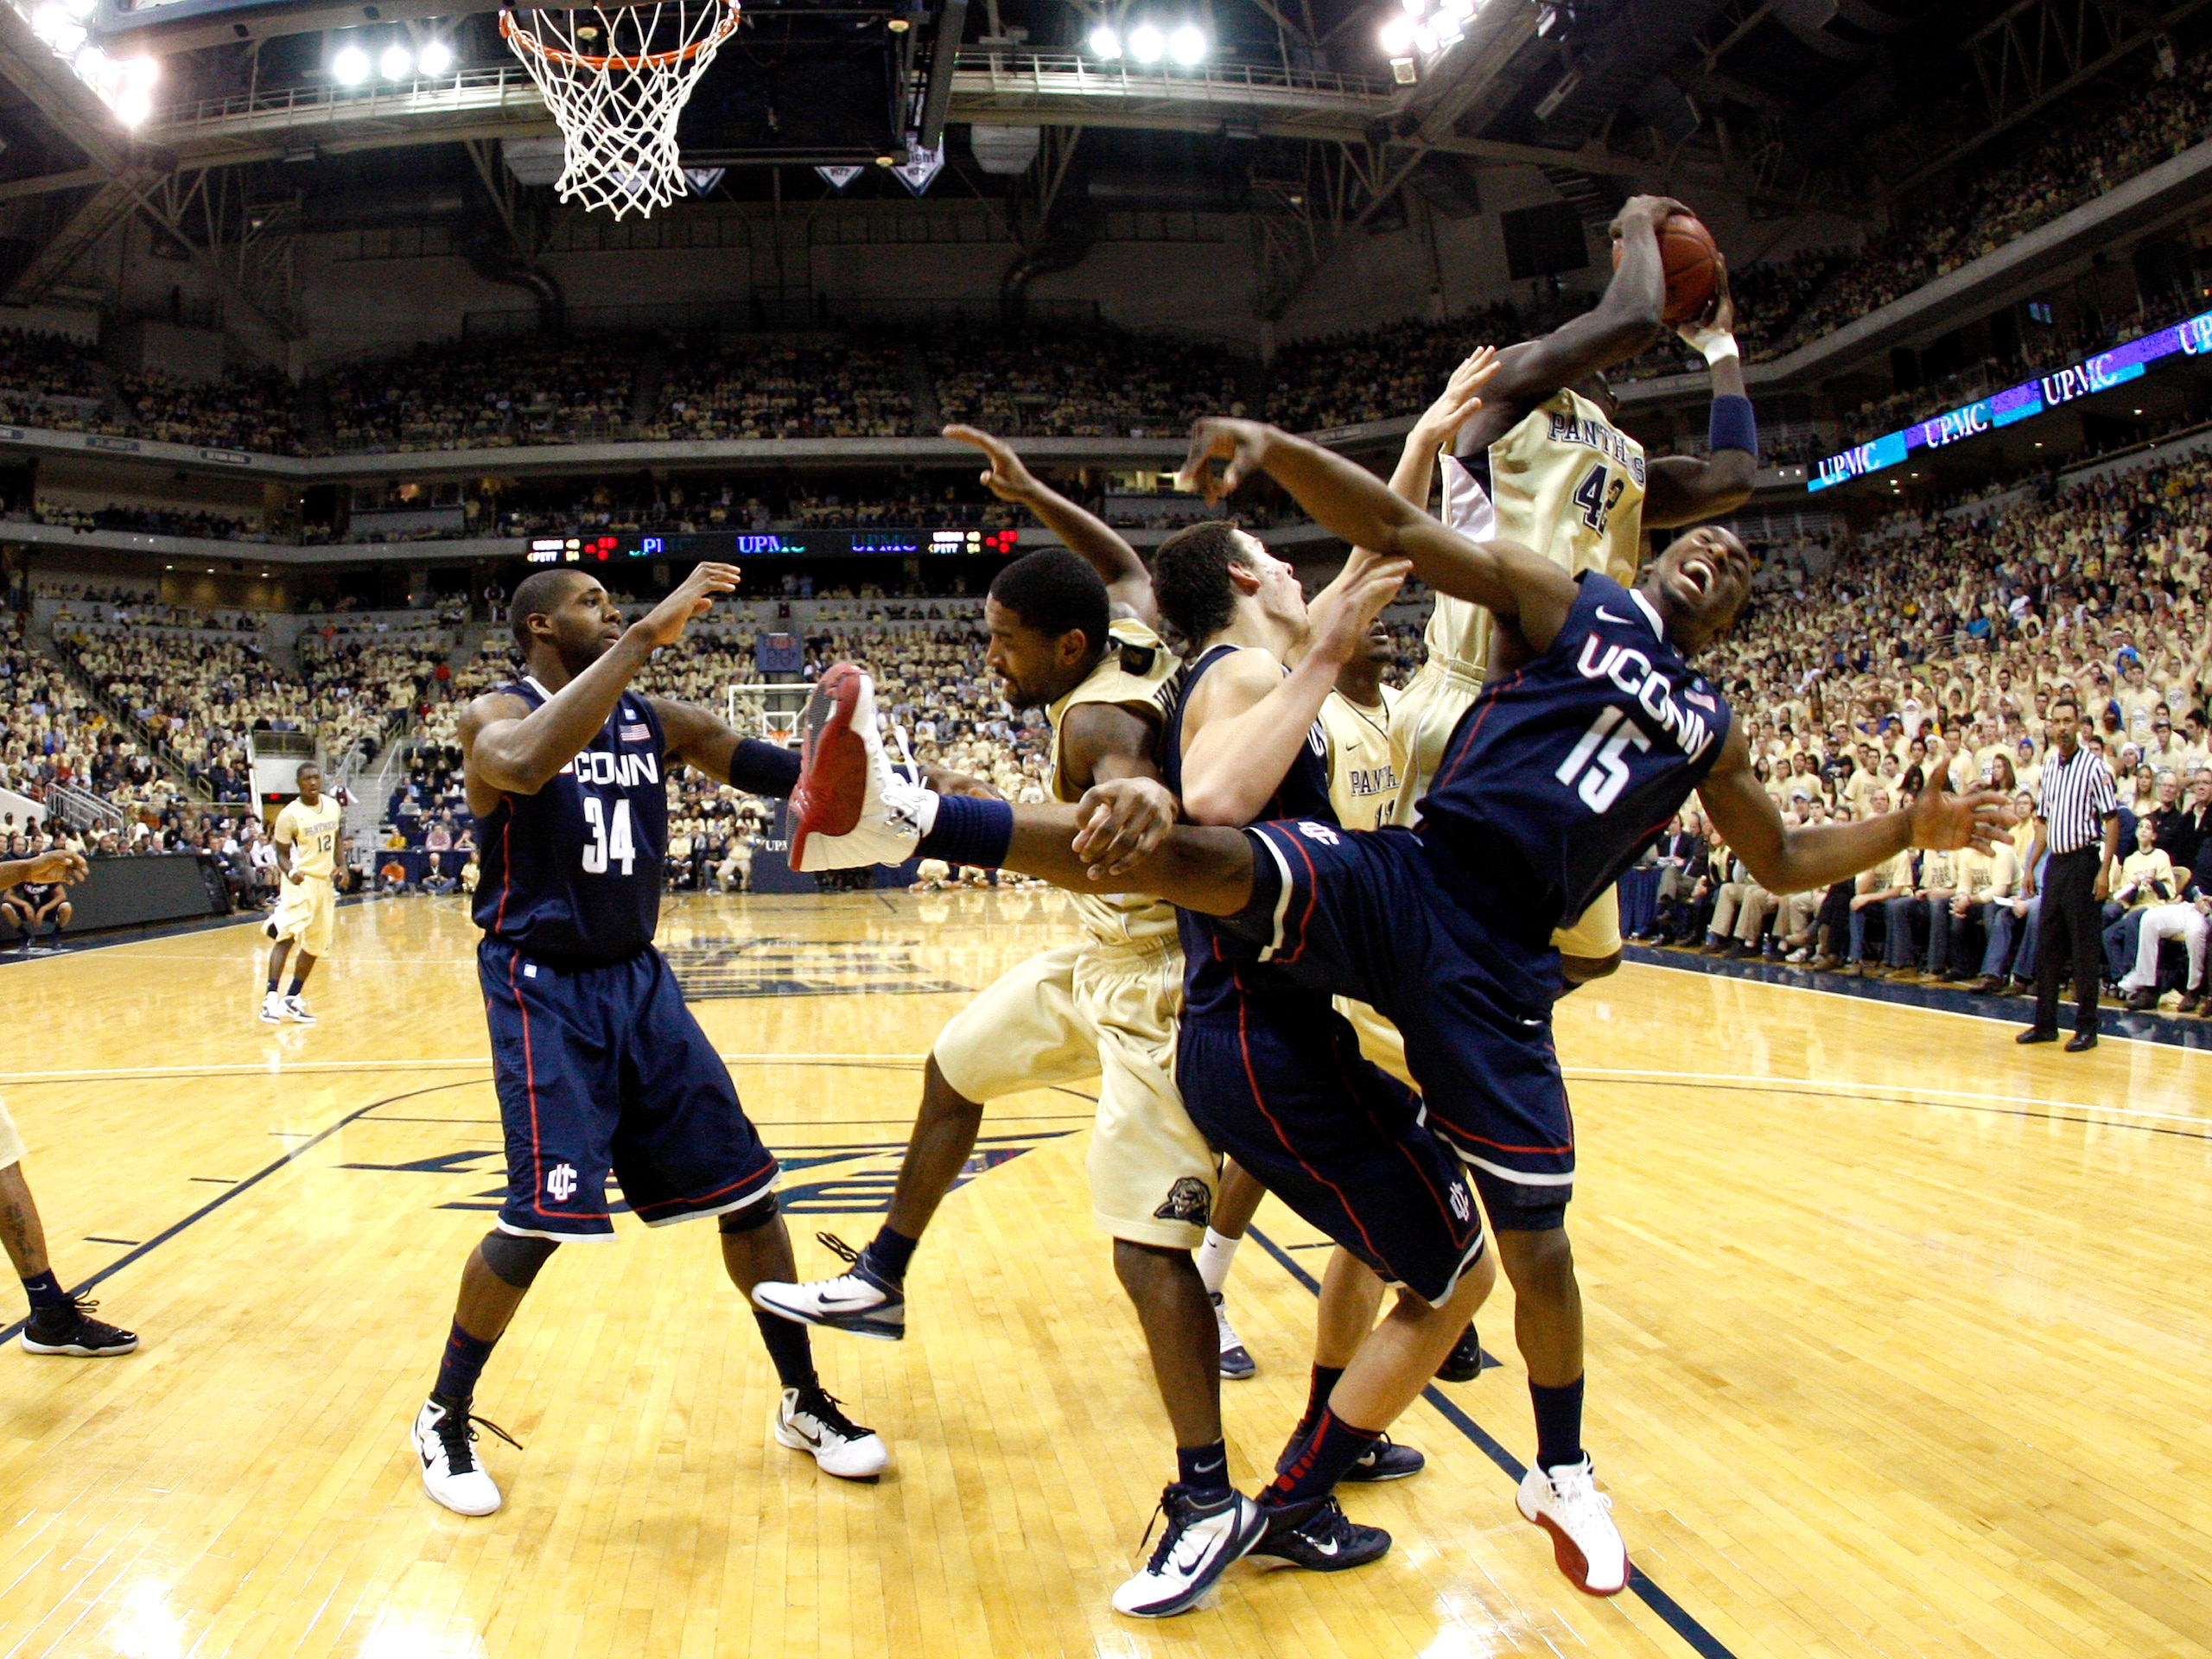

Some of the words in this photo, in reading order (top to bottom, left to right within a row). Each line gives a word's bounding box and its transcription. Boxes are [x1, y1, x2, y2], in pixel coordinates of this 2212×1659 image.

[2042, 353, 2117, 406] UPMC
[1923, 403, 1988, 449] UPMC
[1818, 442, 1881, 486] UPMC
[1573, 462, 1625, 539] 42
[533, 551, 557, 562] PITT
[933, 543, 958, 553] PITT
[1577, 632, 1715, 766] UCONN
[559, 751, 659, 787] CONN
[1555, 705, 1652, 814] 15
[318, 834, 332, 853] 12
[582, 796, 636, 876] 34
